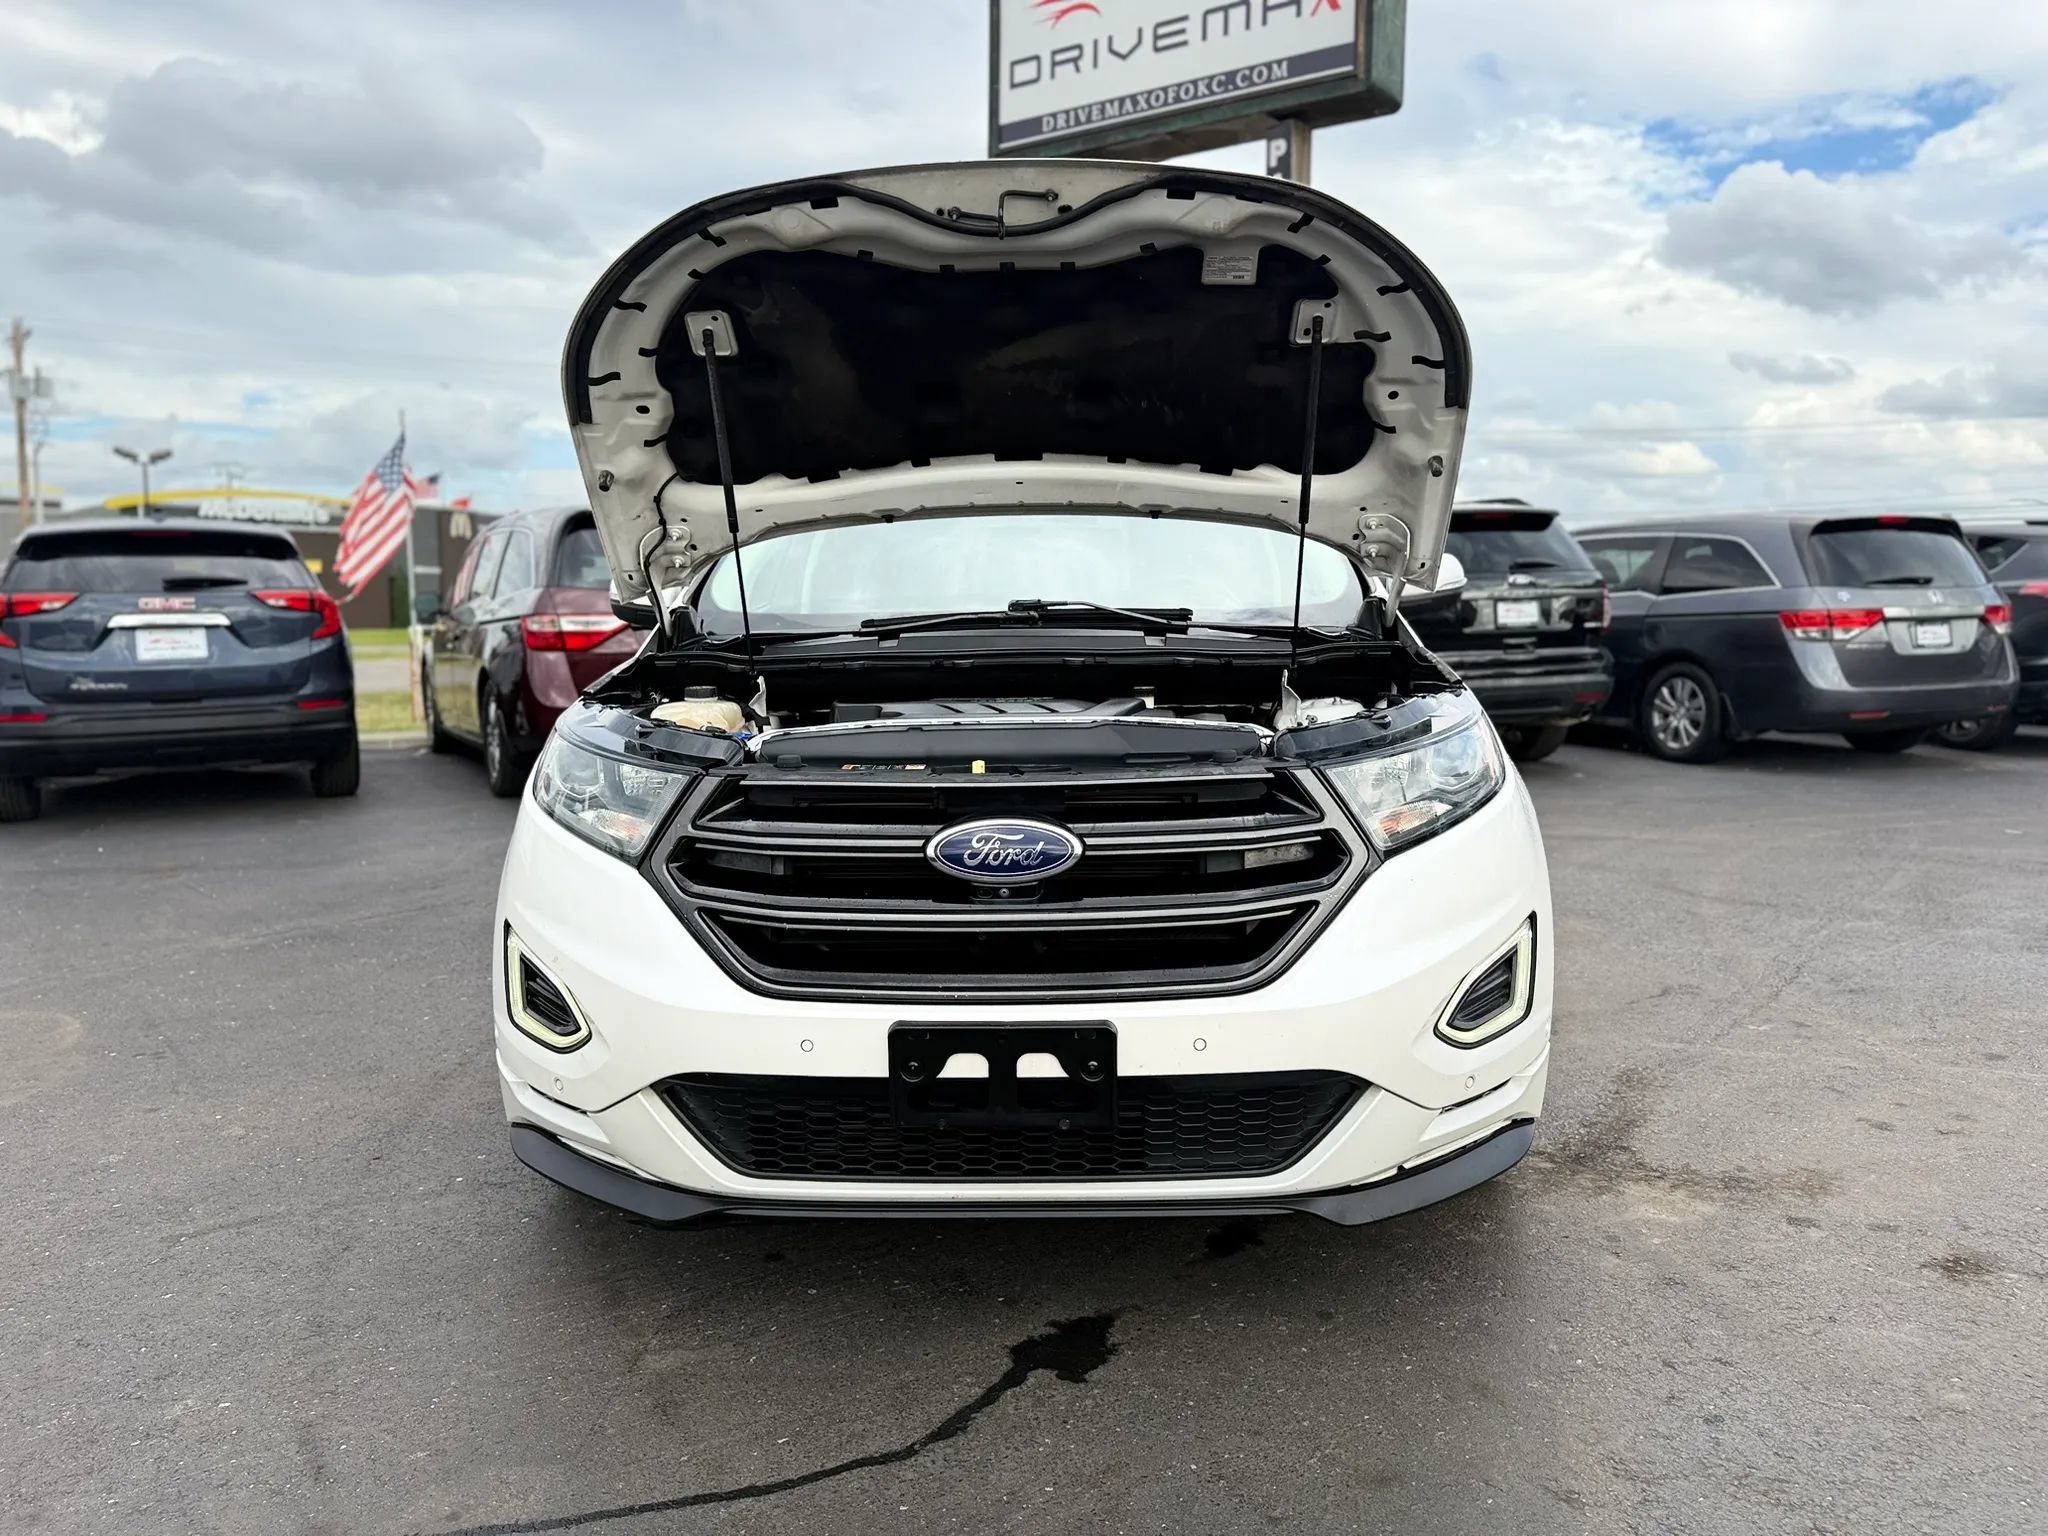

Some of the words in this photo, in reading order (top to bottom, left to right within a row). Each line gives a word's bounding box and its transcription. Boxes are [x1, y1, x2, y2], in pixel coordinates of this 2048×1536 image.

[1041, 61, 1289, 134] DRIVEMAXOFOKC.COM
[138, 597, 196, 610] GMC
[963, 833, 1044, 866] Ford
